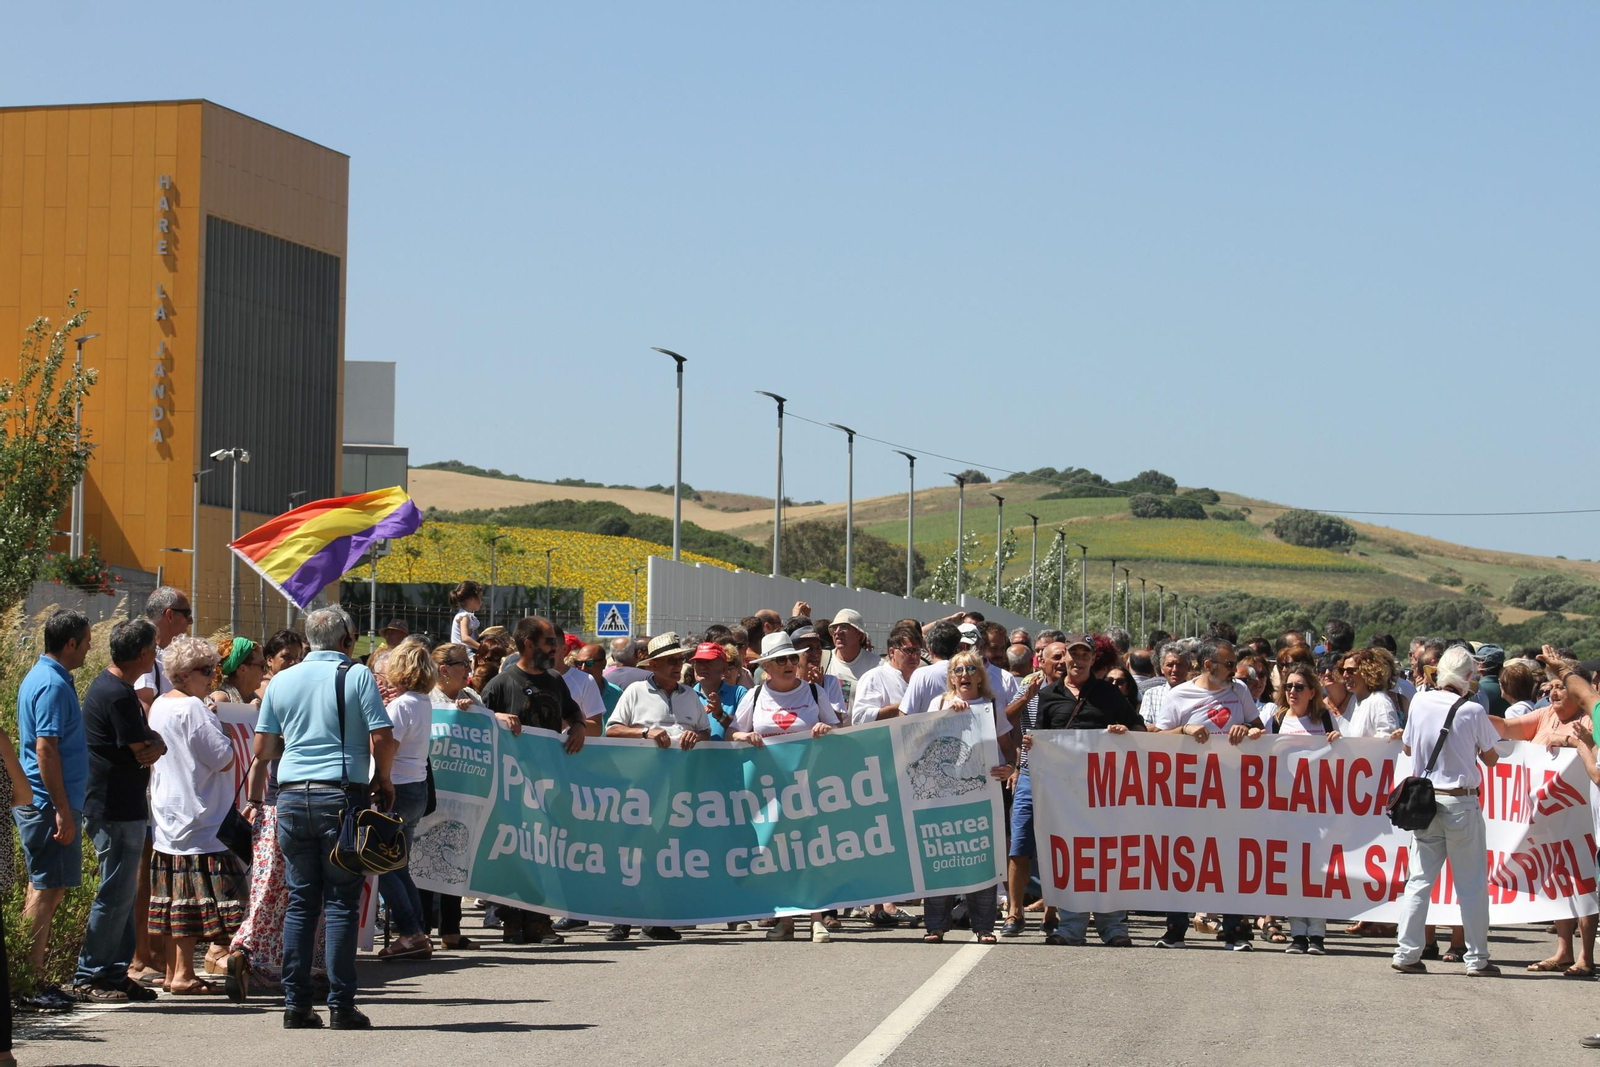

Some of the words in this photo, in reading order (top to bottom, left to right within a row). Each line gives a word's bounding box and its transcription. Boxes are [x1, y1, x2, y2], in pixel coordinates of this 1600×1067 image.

[157, 174, 171, 255] HARE
[155, 283, 166, 320] LA
[152, 340, 165, 443] JANDA
[430, 722, 492, 745] marea
[430, 737, 492, 764] blanca
[431, 758, 487, 777] gaditana
[1087, 751, 1226, 809] MAREA
[1240, 754, 1397, 816] BLANCA
[502, 754, 554, 813] Por
[570, 783, 652, 826] una
[668, 755, 889, 828] sanidad
[920, 816, 989, 839] marea
[488, 822, 606, 874] pública
[618, 847, 643, 887] y
[656, 838, 710, 878] de
[725, 814, 895, 877] calidad
[923, 836, 990, 858] blanca
[933, 853, 987, 872] gaditana
[1050, 834, 1225, 893] DEFENSA
[1238, 837, 1288, 896] DE
[1302, 842, 1351, 899] LA
